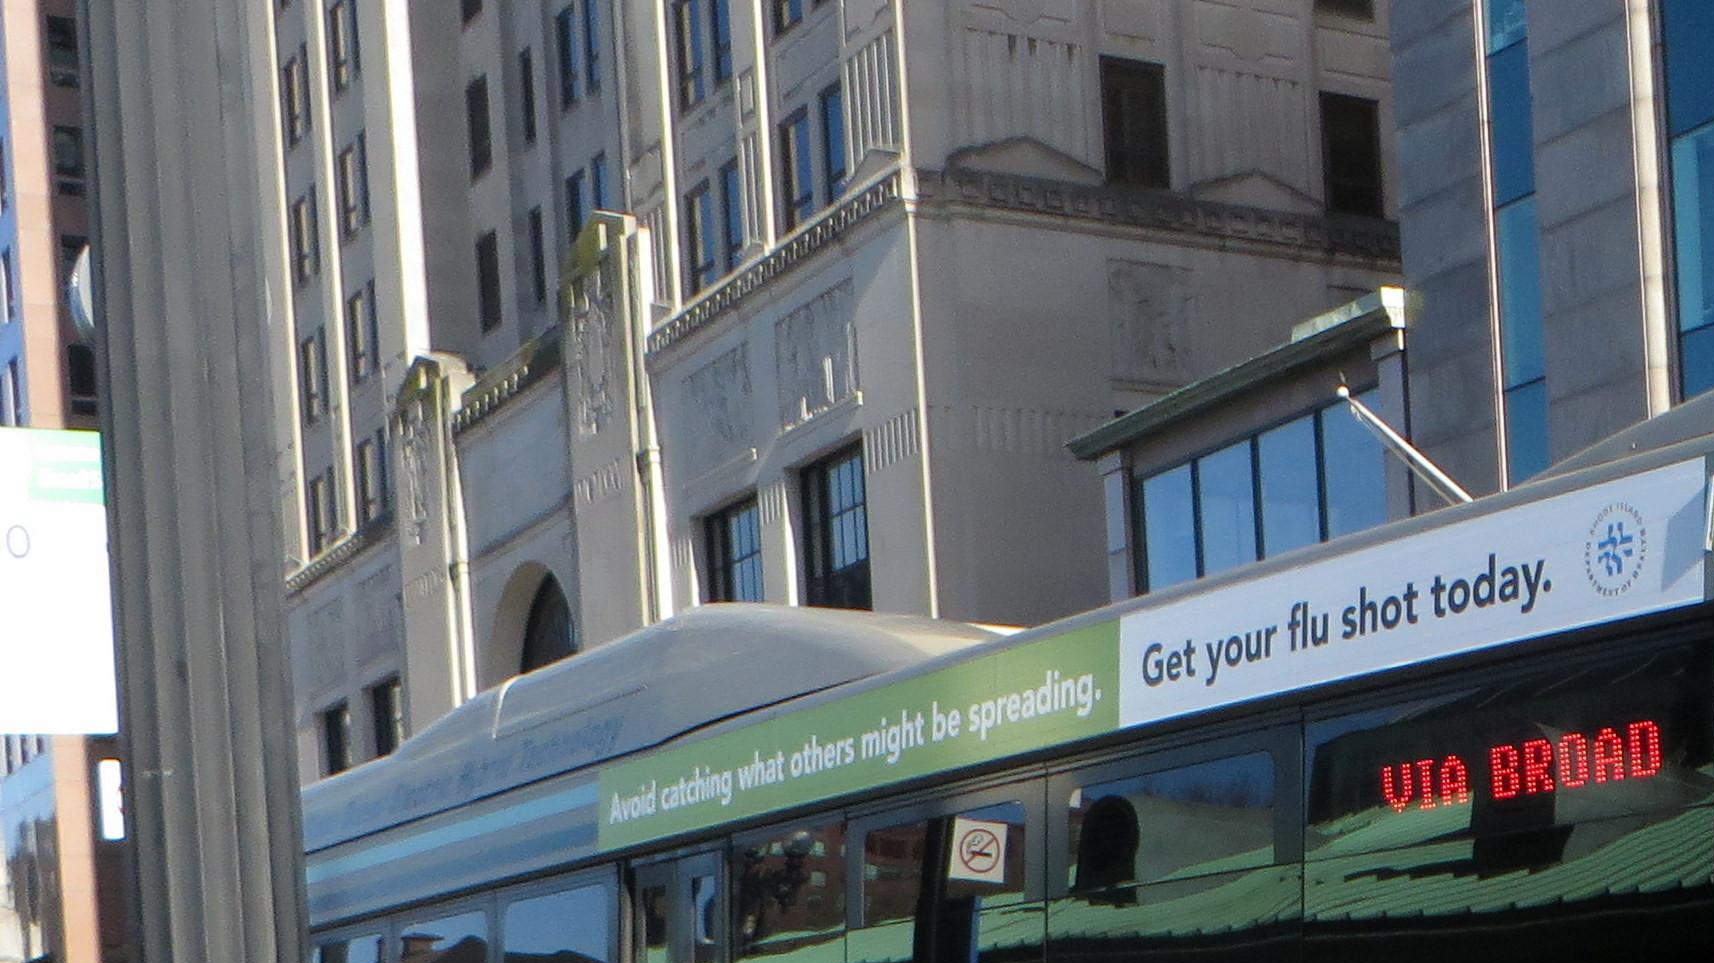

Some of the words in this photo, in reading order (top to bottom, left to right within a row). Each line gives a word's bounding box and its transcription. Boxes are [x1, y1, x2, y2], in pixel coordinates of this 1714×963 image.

[1143, 640, 1195, 686] Get
[1206, 626, 1277, 686] your
[1288, 602, 1328, 651] flu
[1342, 583, 1418, 639] shot
[1431, 554, 1551, 617] today.
[610, 780, 656, 824] Avoid
[661, 766, 732, 810] catching
[738, 751, 784, 790] what
[791, 735, 854, 777] others
[861, 714, 925, 765] might
[933, 702, 960, 741] be
[967, 667, 1103, 742] spreading.
[1381, 755, 1468, 809] VIA
[1490, 721, 1662, 800] BROAD
